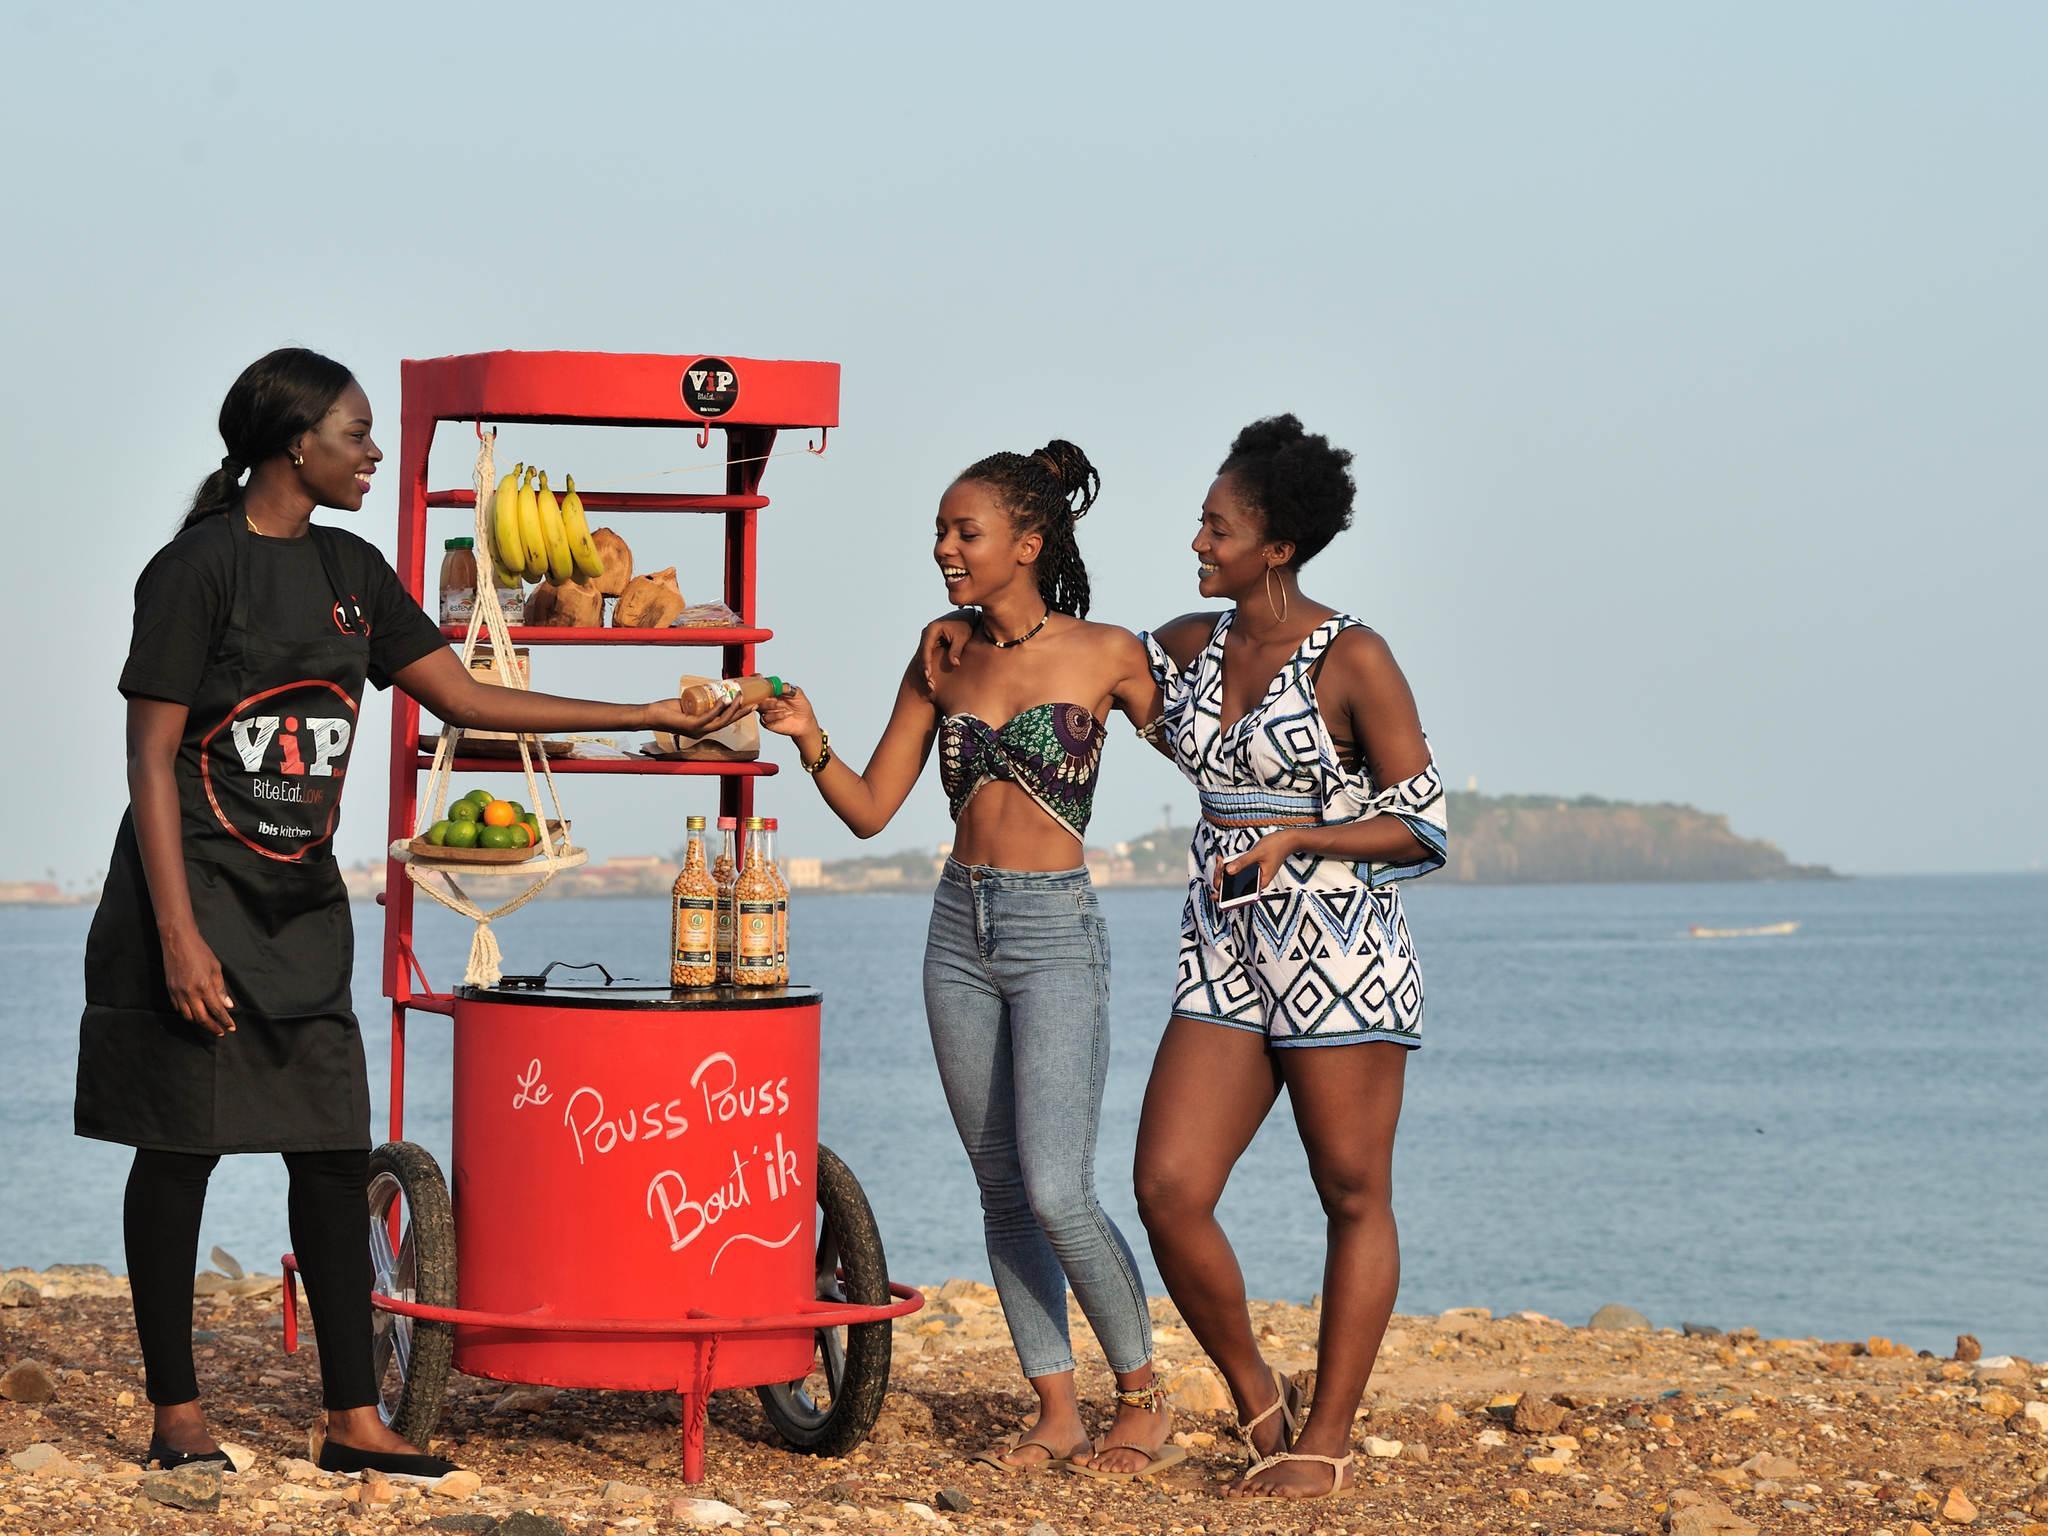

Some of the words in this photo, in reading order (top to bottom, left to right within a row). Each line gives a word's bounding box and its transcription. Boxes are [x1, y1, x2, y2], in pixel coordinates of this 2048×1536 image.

[449, 604, 475, 612] estev
[258, 821, 279, 836] ibis
[280, 825, 312, 837] kitchen
[513, 1058, 553, 1109] Le
[564, 1086, 689, 1165] Pouss
[690, 1051, 790, 1124] Pouss
